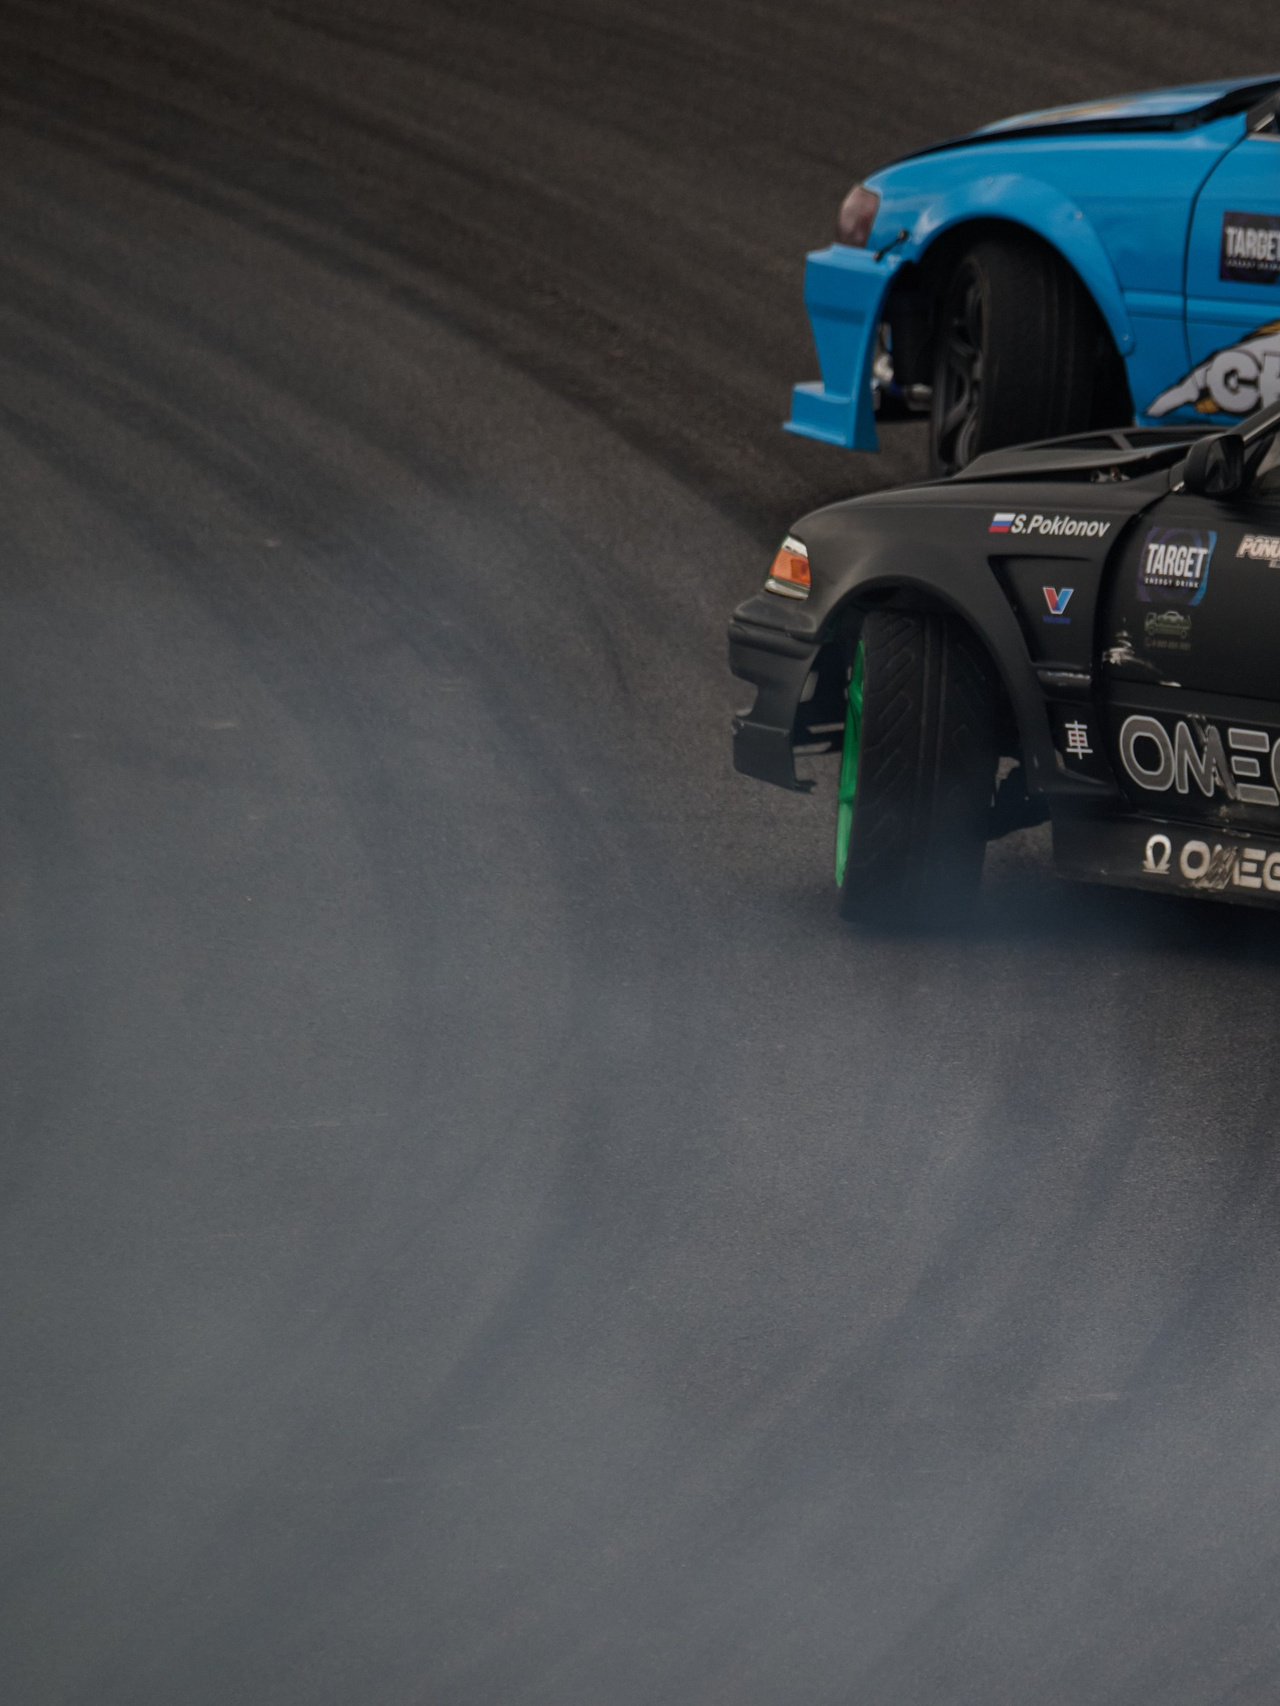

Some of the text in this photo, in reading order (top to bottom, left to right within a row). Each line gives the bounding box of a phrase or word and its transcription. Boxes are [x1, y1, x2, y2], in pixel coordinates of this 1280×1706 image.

[1010, 514, 1111, 538] S.Poklonov
[1145, 543, 1209, 580] TARGET
[1144, 577, 1199, 588] ENERGY DRINK
[1065, 721, 1094, 760] 車
